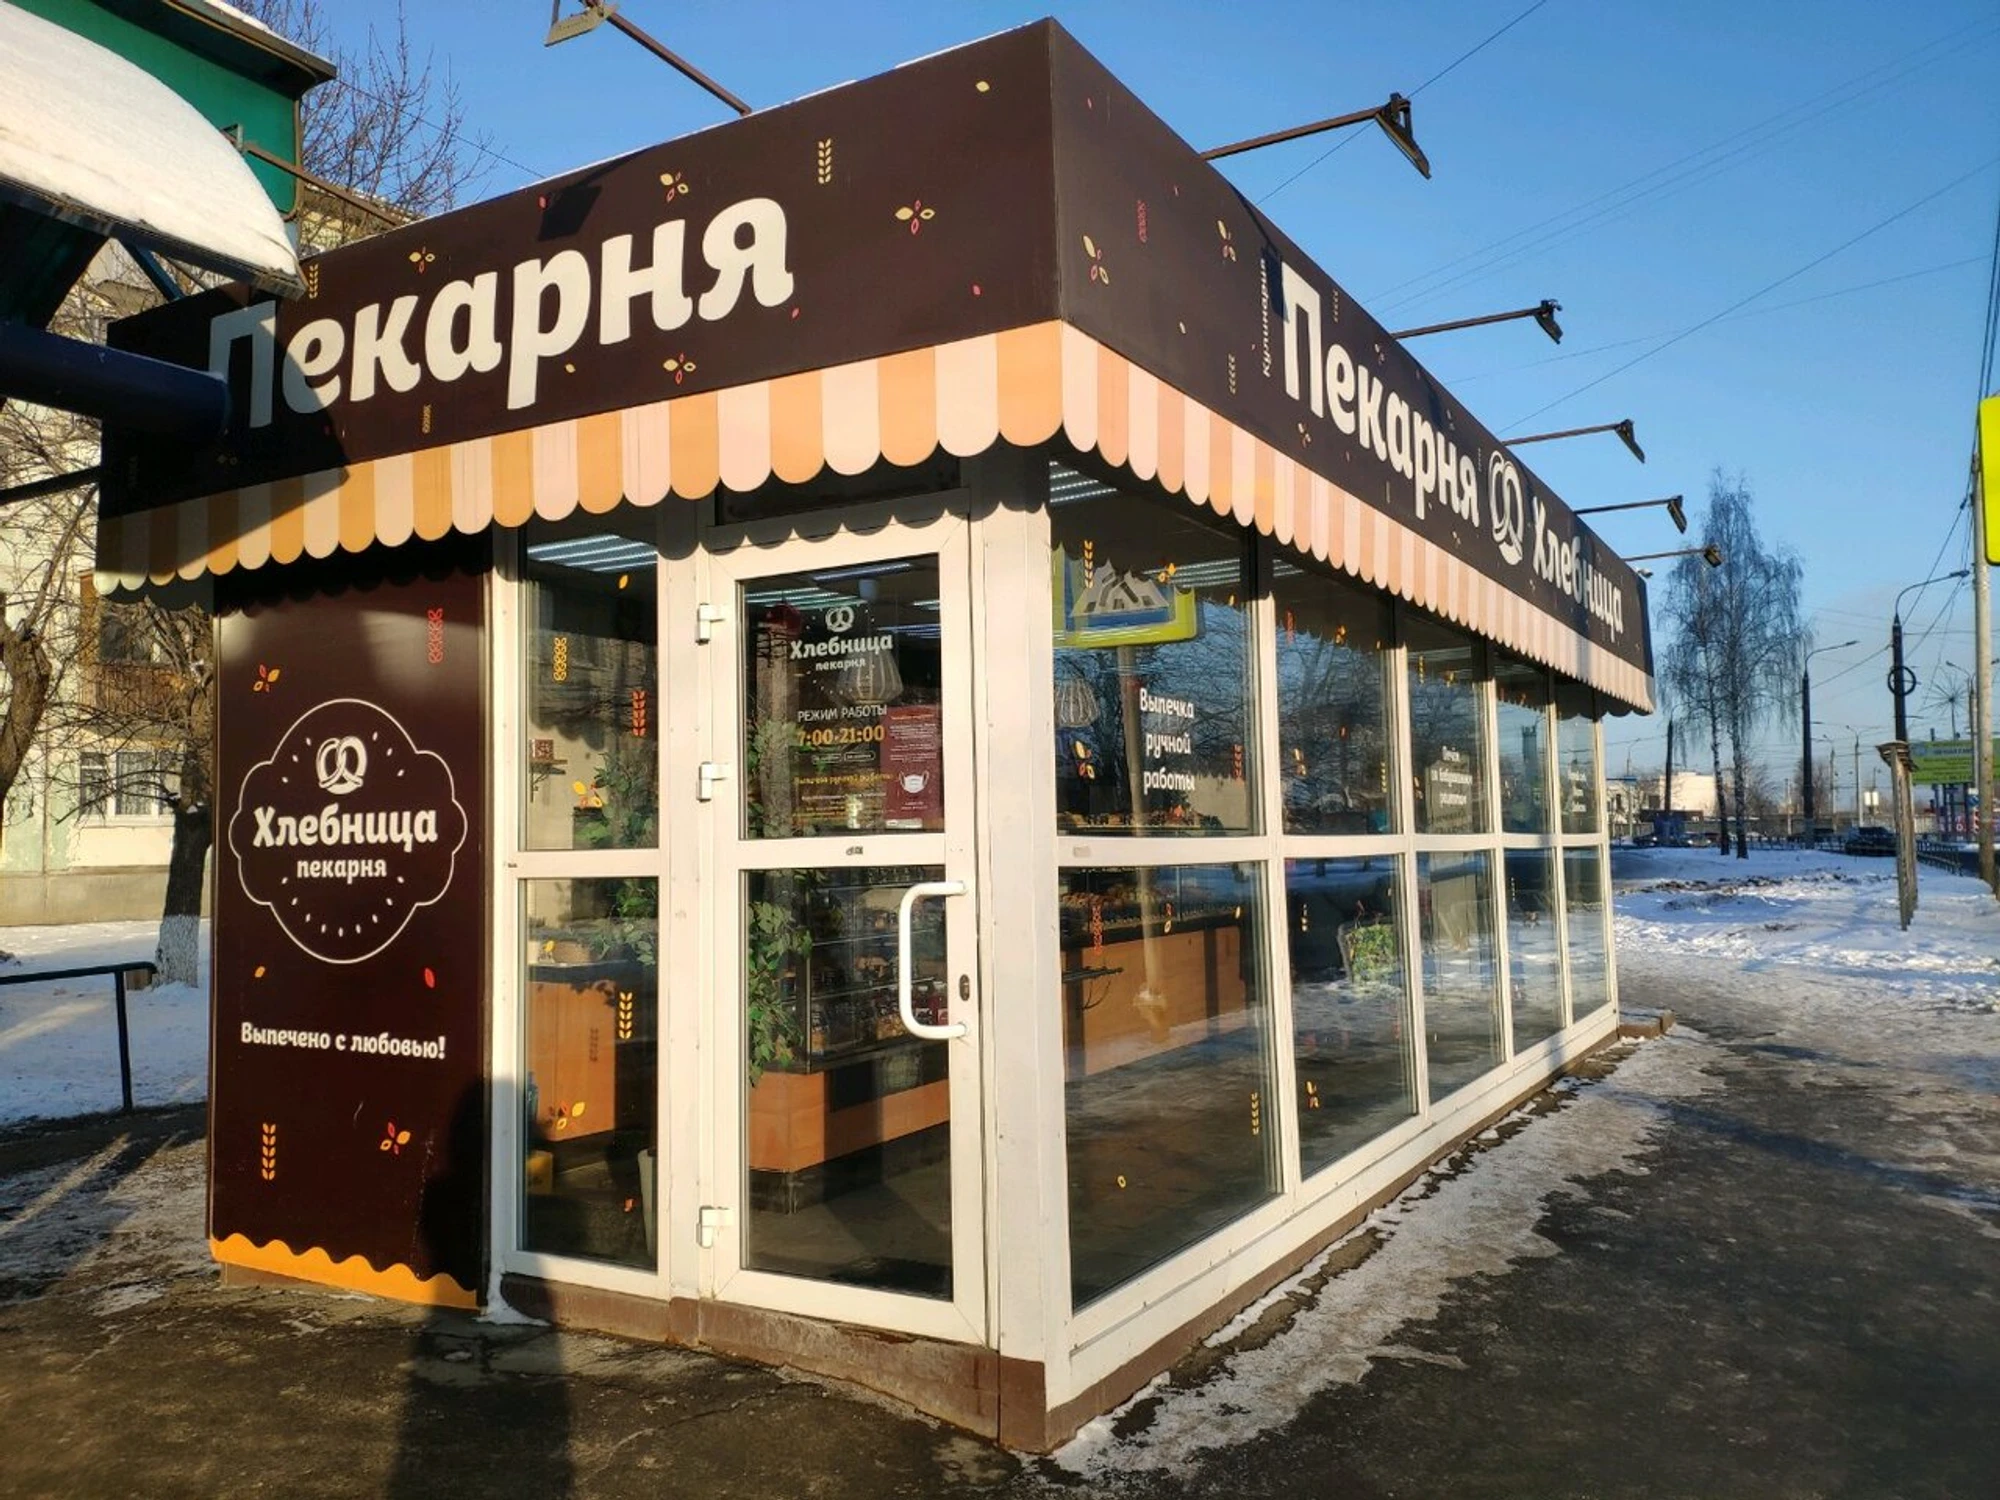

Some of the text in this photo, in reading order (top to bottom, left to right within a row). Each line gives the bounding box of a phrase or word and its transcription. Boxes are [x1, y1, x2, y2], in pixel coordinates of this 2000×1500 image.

[208, 197, 796, 429] Пекарня
[1281, 261, 1624, 635] Пекарня Хлебница
[790, 633, 894, 660] Хлебница
[815, 659, 867, 672] пекарня
[797, 707, 838, 723] РЕЖИМ
[840, 704, 888, 719] РАБОТЫ
[1139, 688, 1195, 719] Выпечка
[1145, 733, 1192, 760] ручной
[1143, 766, 1196, 795] работы
[253, 803, 439, 853] Хлебница
[297, 858, 388, 884] пекарня
[241, 1022, 446, 1060] Выпечено с любовью!
